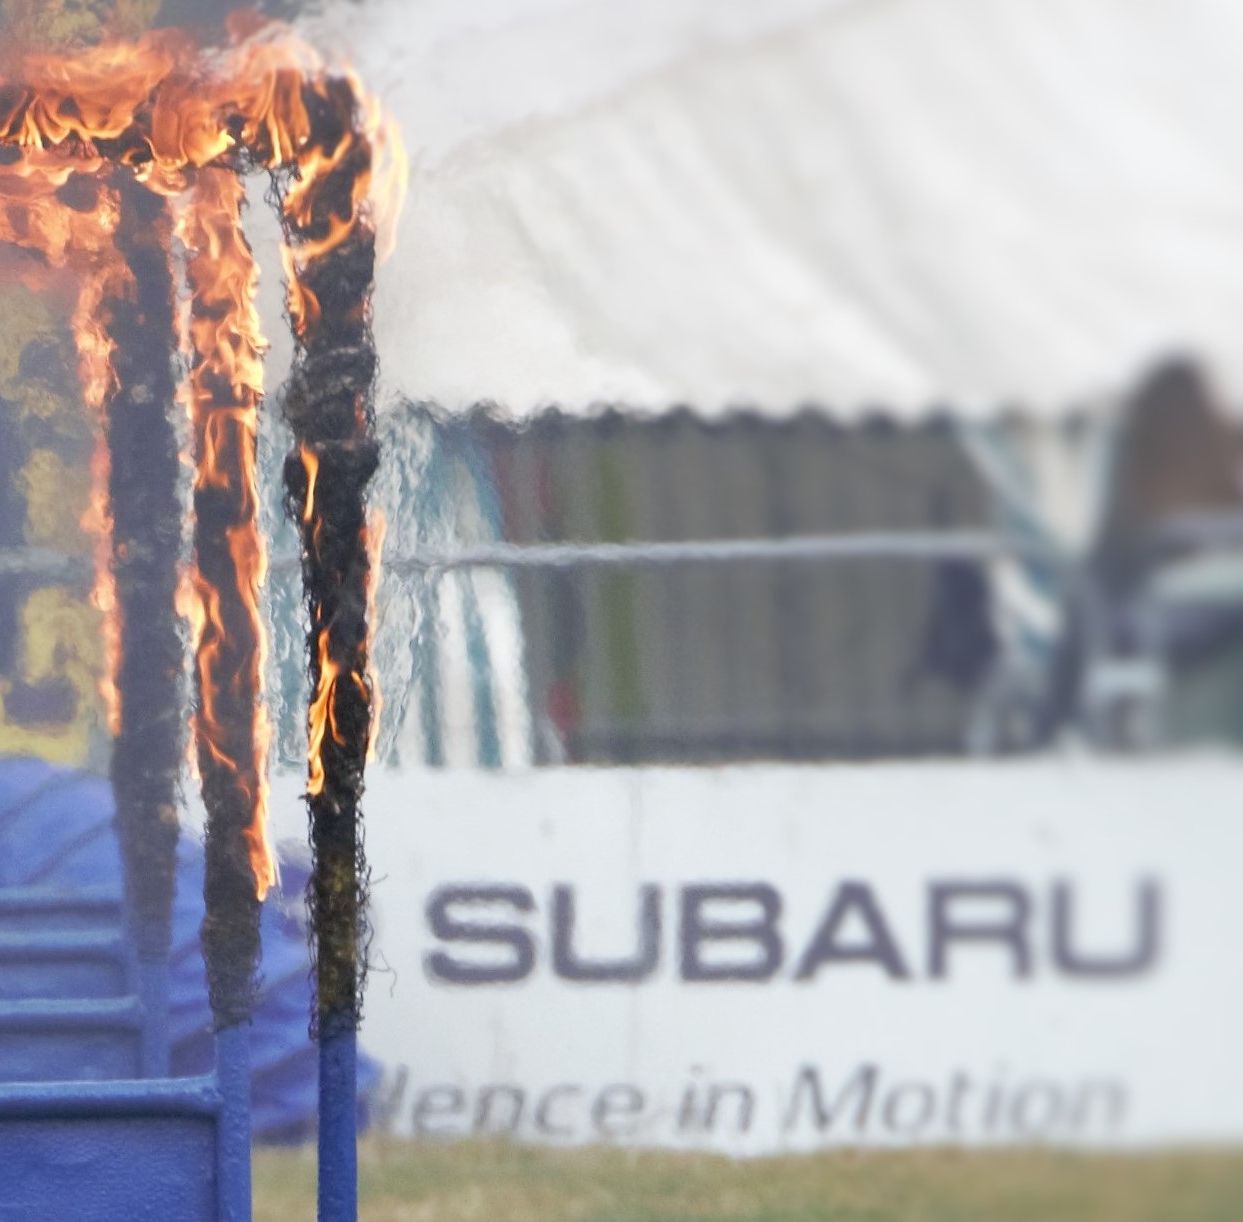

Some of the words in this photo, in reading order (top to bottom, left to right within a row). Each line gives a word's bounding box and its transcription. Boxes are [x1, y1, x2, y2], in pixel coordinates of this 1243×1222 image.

[421, 876, 1166, 986] SUBARU
[676, 1064, 756, 1136] in
[783, 1060, 1130, 1136] Motion
